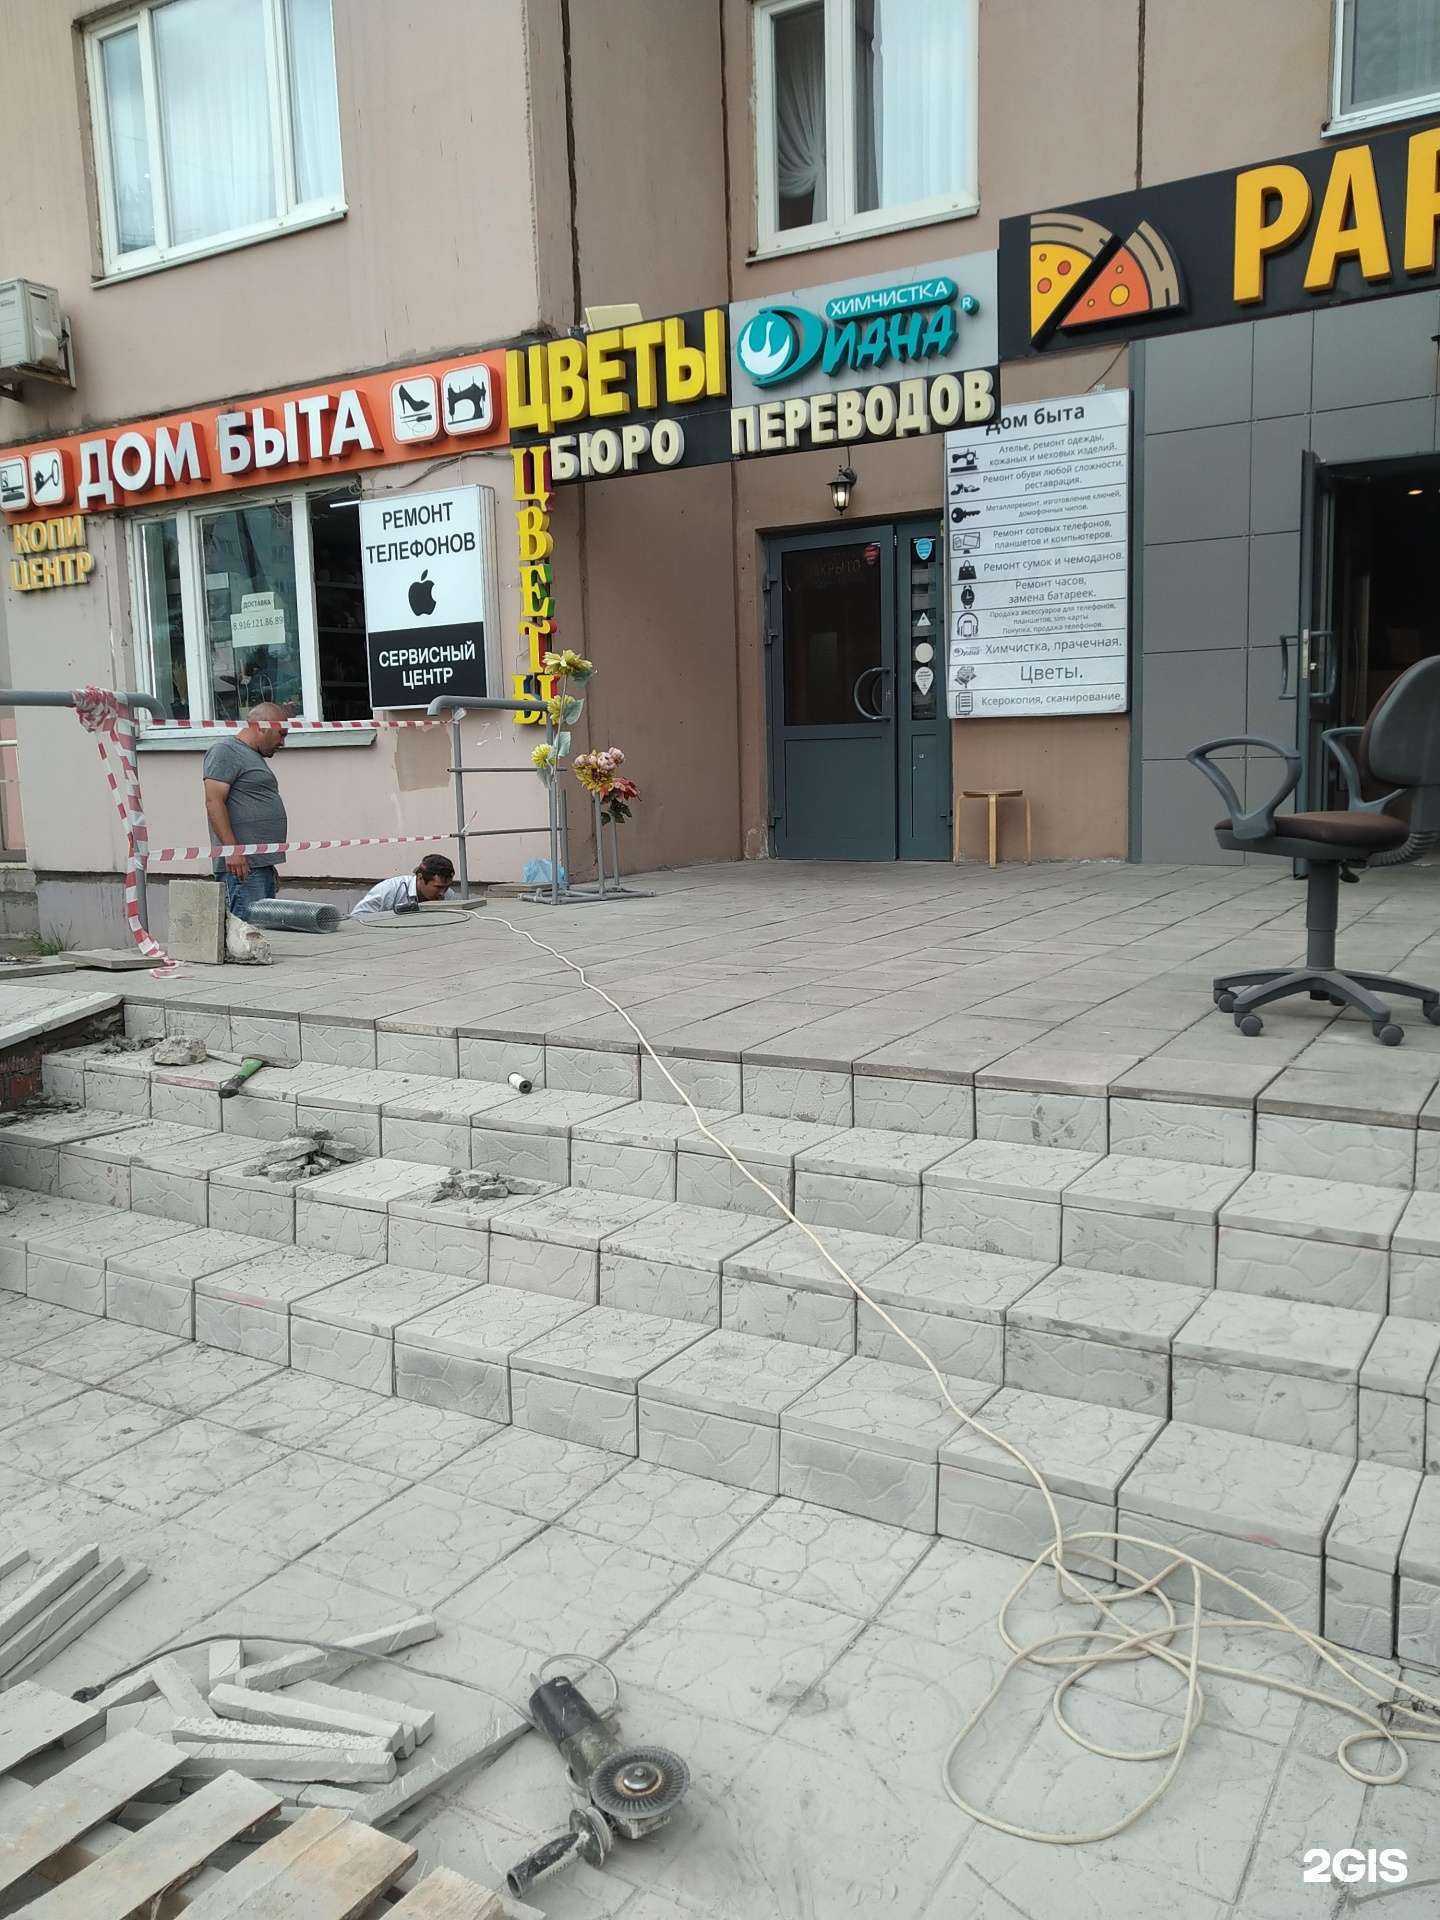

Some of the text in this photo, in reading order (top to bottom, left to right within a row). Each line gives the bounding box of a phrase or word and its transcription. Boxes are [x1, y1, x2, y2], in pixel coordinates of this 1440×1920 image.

[830, 281, 948, 317] ХИМЧИСТКА
[507, 309, 727, 433] ЦВЕТЫ
[1034, 405, 1085, 425] быта
[551, 370, 996, 480] БЮРО ПЕРЕВОДОВ
[78, 389, 379, 509] ДОМ БЫТА
[1033, 438, 1065, 452] ремонт
[989, 455, 1027, 467] кожаных
[1037, 449, 1076, 460] меховых
[982, 473, 1014, 484] Ремонт
[1016, 470, 1042, 483] обуви
[1044, 465, 1073, 476] любой
[382, 502, 454, 530] РЕМОНТ
[12, 515, 86, 554] КОПИ
[993, 529, 1024, 539] Ремонт
[1026, 525, 1061, 535] сотовых
[366, 532, 476, 564] ТЕЛЕФОНОВ
[994, 538, 1041, 550] планшетов
[10, 551, 94, 591] ЦЕНТР
[983, 562, 1020, 573] Ремонт
[1022, 559, 1051, 571] сумок
[1054, 558, 1061, 566] и
[1015, 580, 1051, 591] Ремонт
[1008, 590, 1097, 604] замена батареек.
[379, 641, 476, 668] СЕРВИСНЫЙ
[985, 643, 1050, 655] Химчистка,
[1053, 637, 1122, 652] прачечная.
[402, 667, 454, 689] ЦЕНТР
[1020, 666, 1083, 683] Цветы.
[981, 695, 1043, 708] Ксерокопия,
